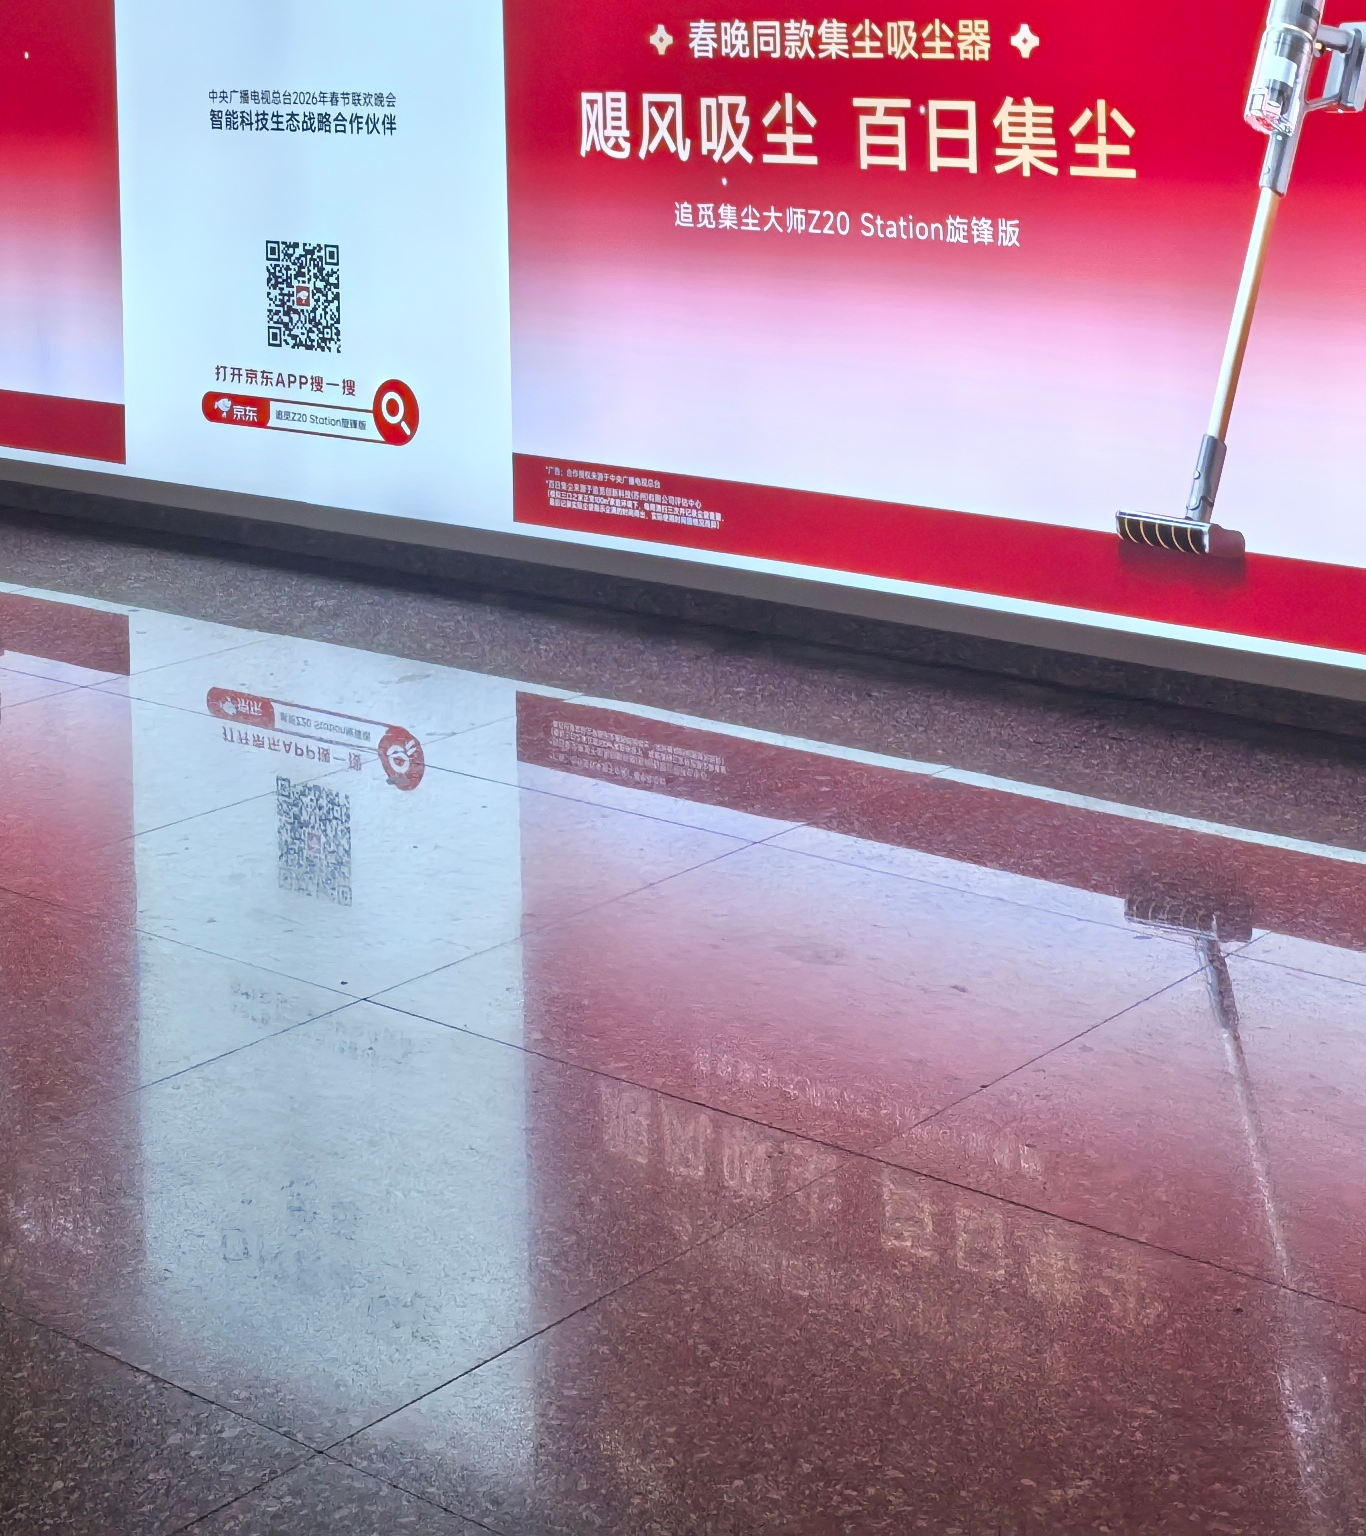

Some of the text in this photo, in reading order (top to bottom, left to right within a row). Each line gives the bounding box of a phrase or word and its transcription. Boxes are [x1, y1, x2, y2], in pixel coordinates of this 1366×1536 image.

[689, 18, 991, 61] 春晚同款集尘吸尘器
[208, 89, 397, 107] 中央广播电视总台2026年春节联欢晚会
[210, 109, 396, 135] 智能科技生态战略合作伙伴
[580, 92, 1136, 178] 飓风吸尘 百日集尘
[675, 202, 1020, 247] 追觅集尘大师Z20 Station旋锋版
[215, 365, 355, 396] 打开京东APP搜一搜
[233, 405, 258, 422] 京东
